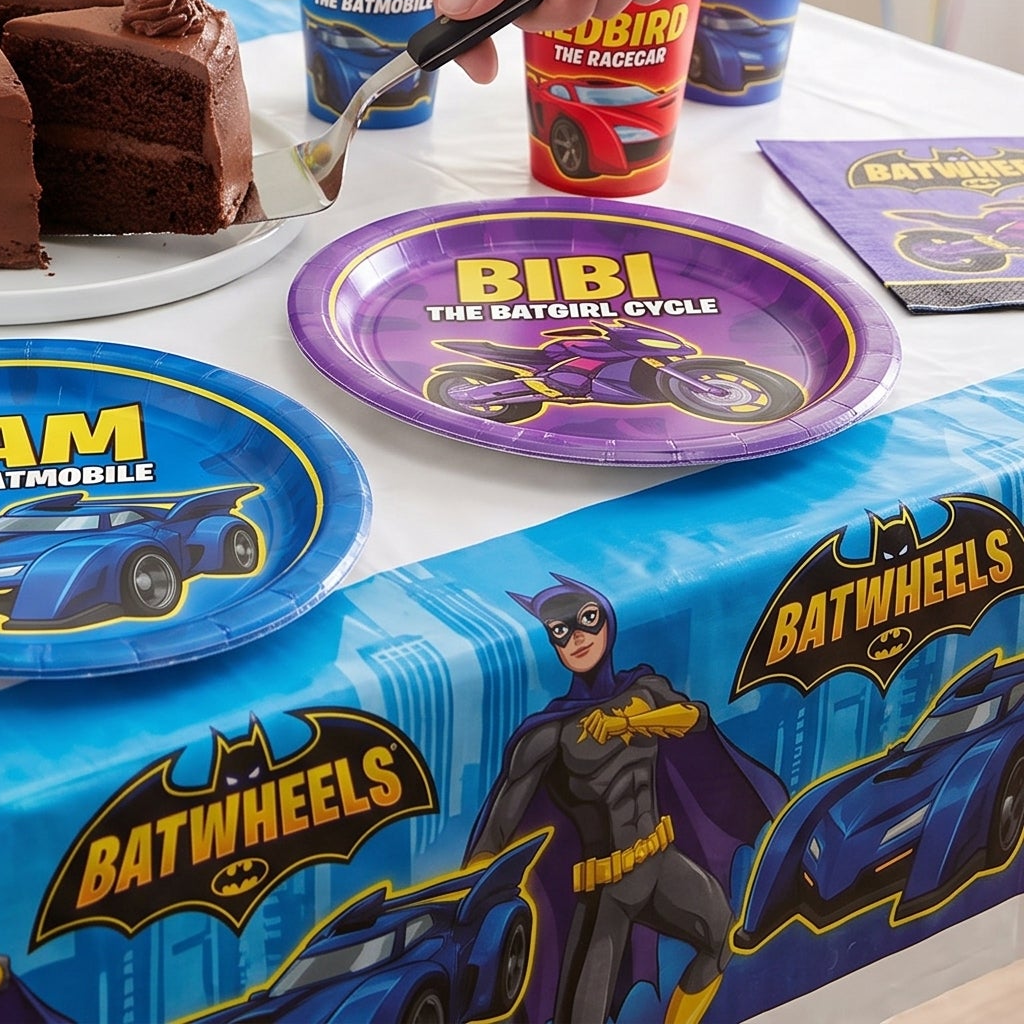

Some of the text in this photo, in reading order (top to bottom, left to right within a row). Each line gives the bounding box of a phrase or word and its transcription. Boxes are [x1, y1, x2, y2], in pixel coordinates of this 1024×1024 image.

[538, 3, 689, 48] DBIRD
[554, 44, 667, 68] THE RACECAR
[456, 253, 660, 303] BIBI
[426, 297, 718, 322] THE BATGIRL CYCLE
[766, 528, 1013, 667] BATWHEELS
[76, 745, 403, 910] BATWHEELS
